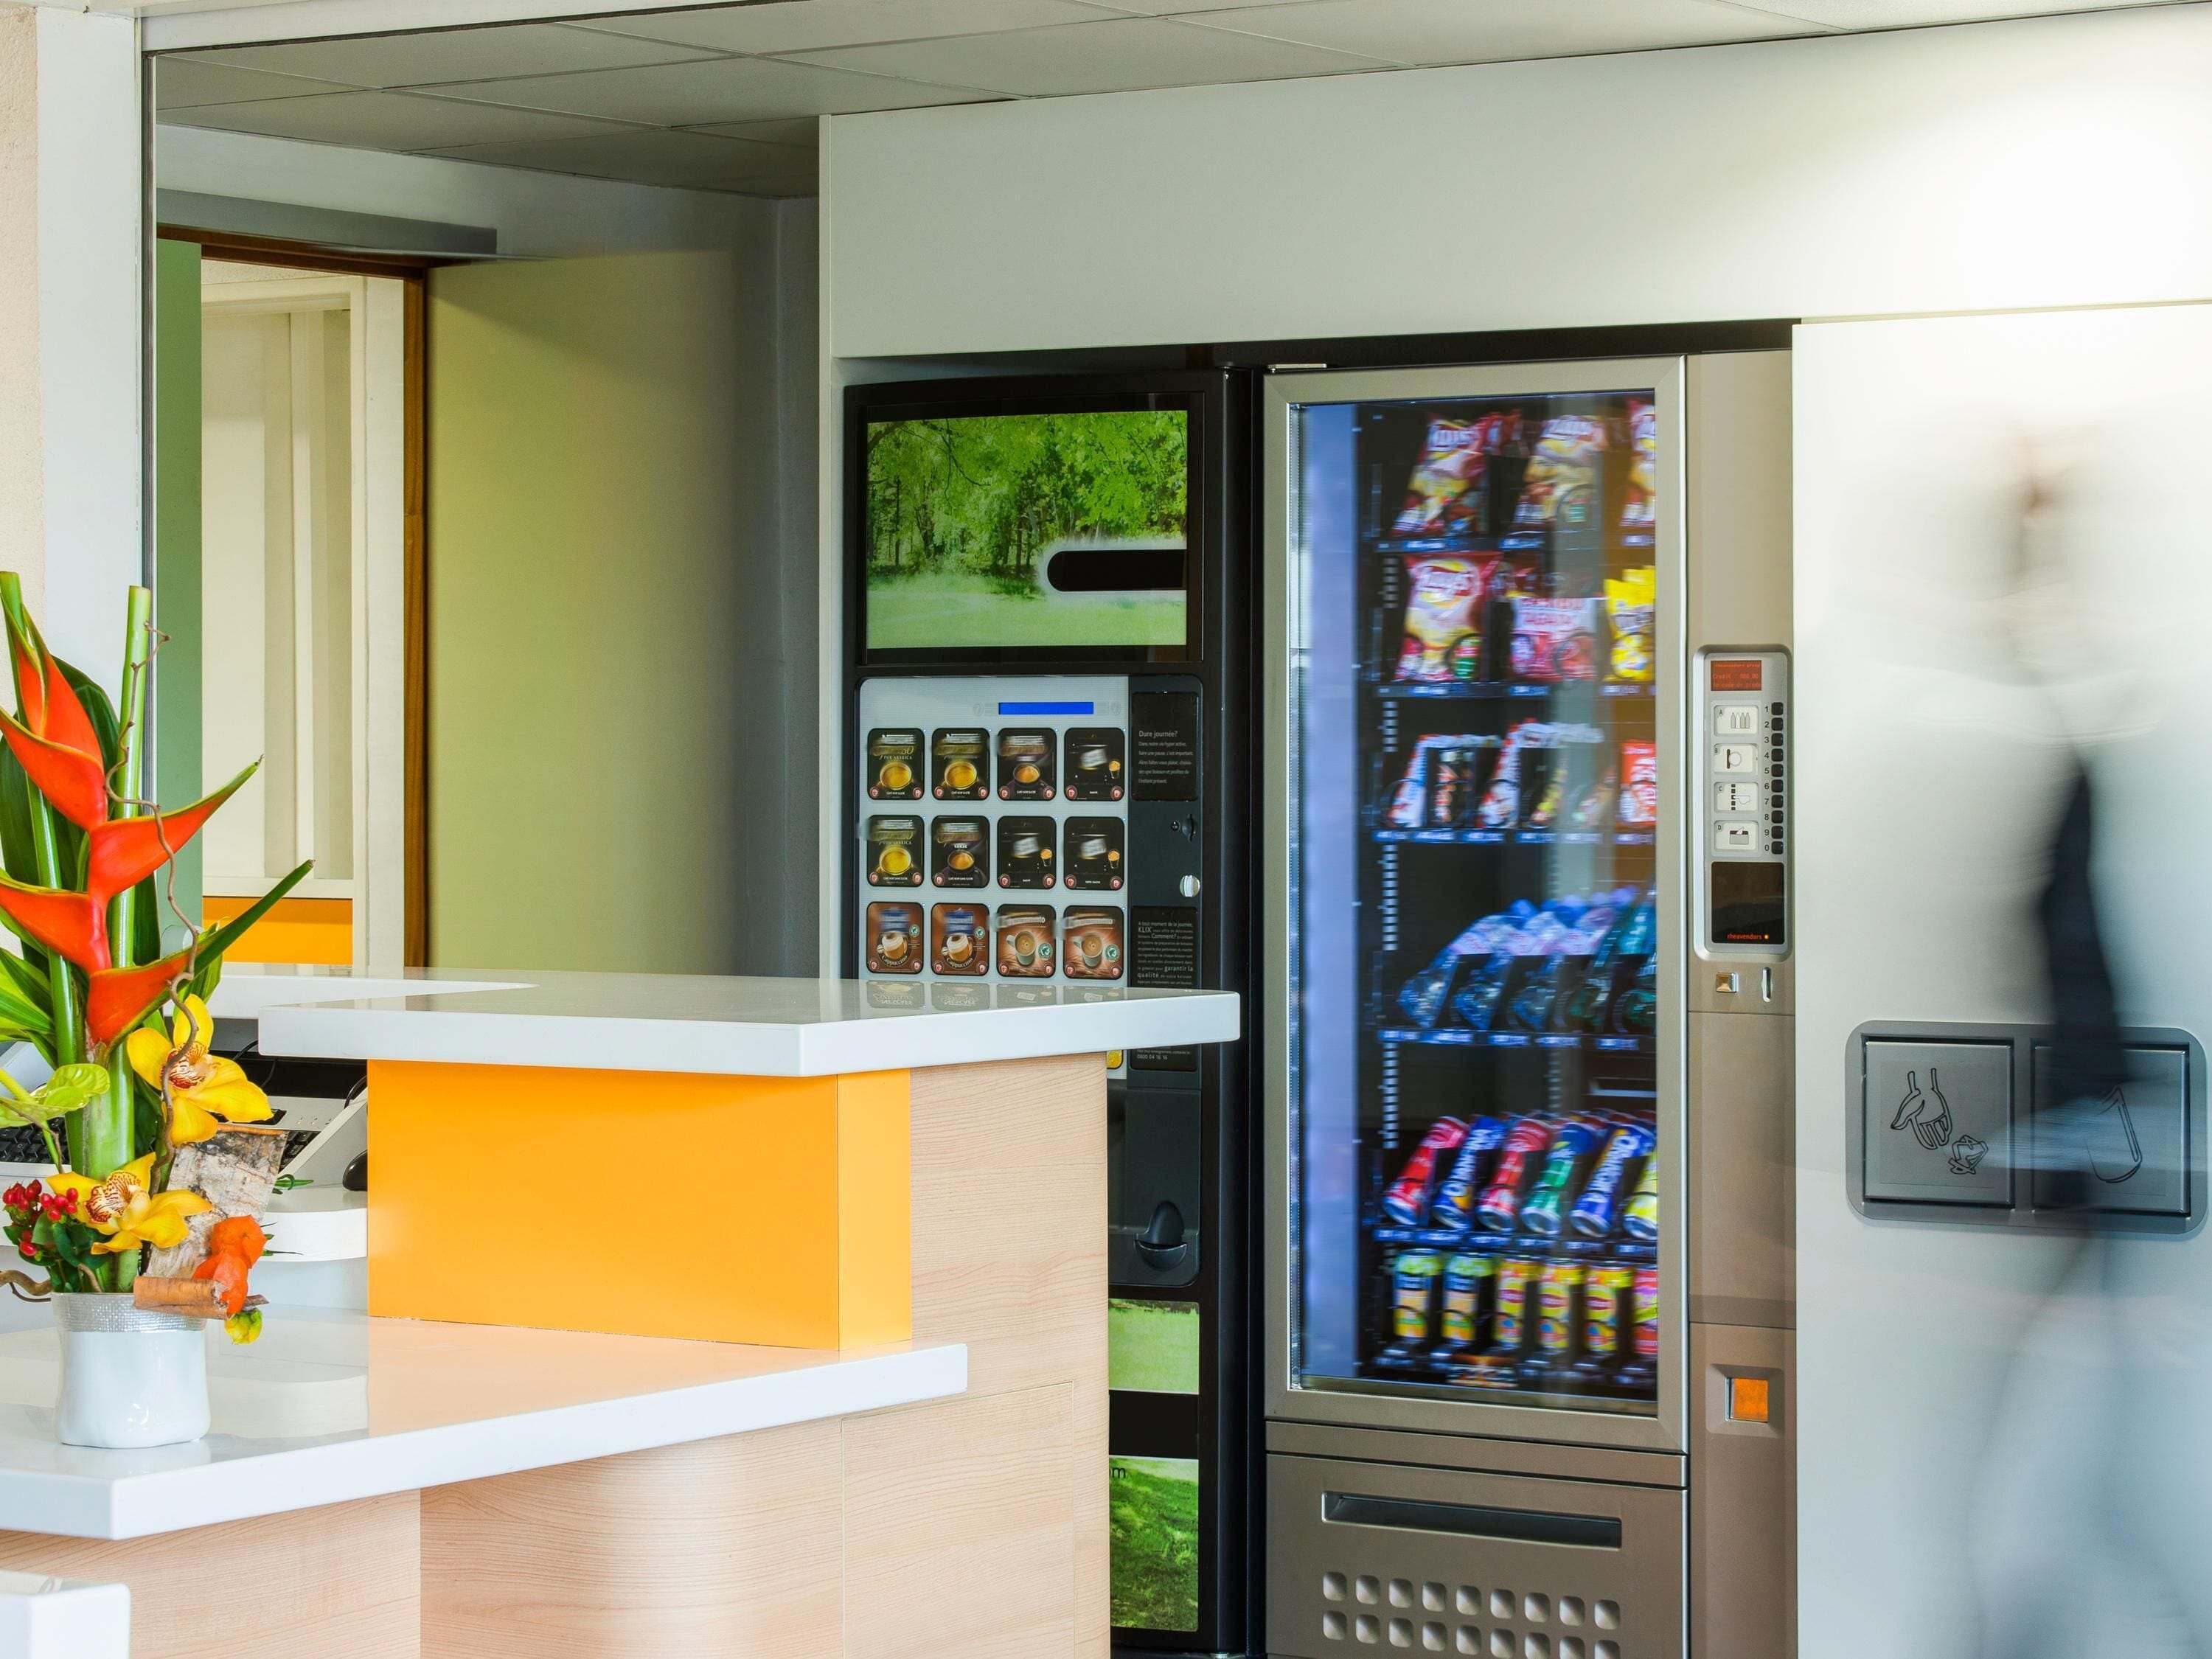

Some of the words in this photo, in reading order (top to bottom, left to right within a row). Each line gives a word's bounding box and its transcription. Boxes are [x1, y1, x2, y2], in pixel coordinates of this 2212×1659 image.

[1153, 730, 1179, 739] journée?
[882, 955, 908, 966] Cappuccino
[947, 957, 973, 968] Cappuccino
[1109, 1467, 1127, 1478] m
